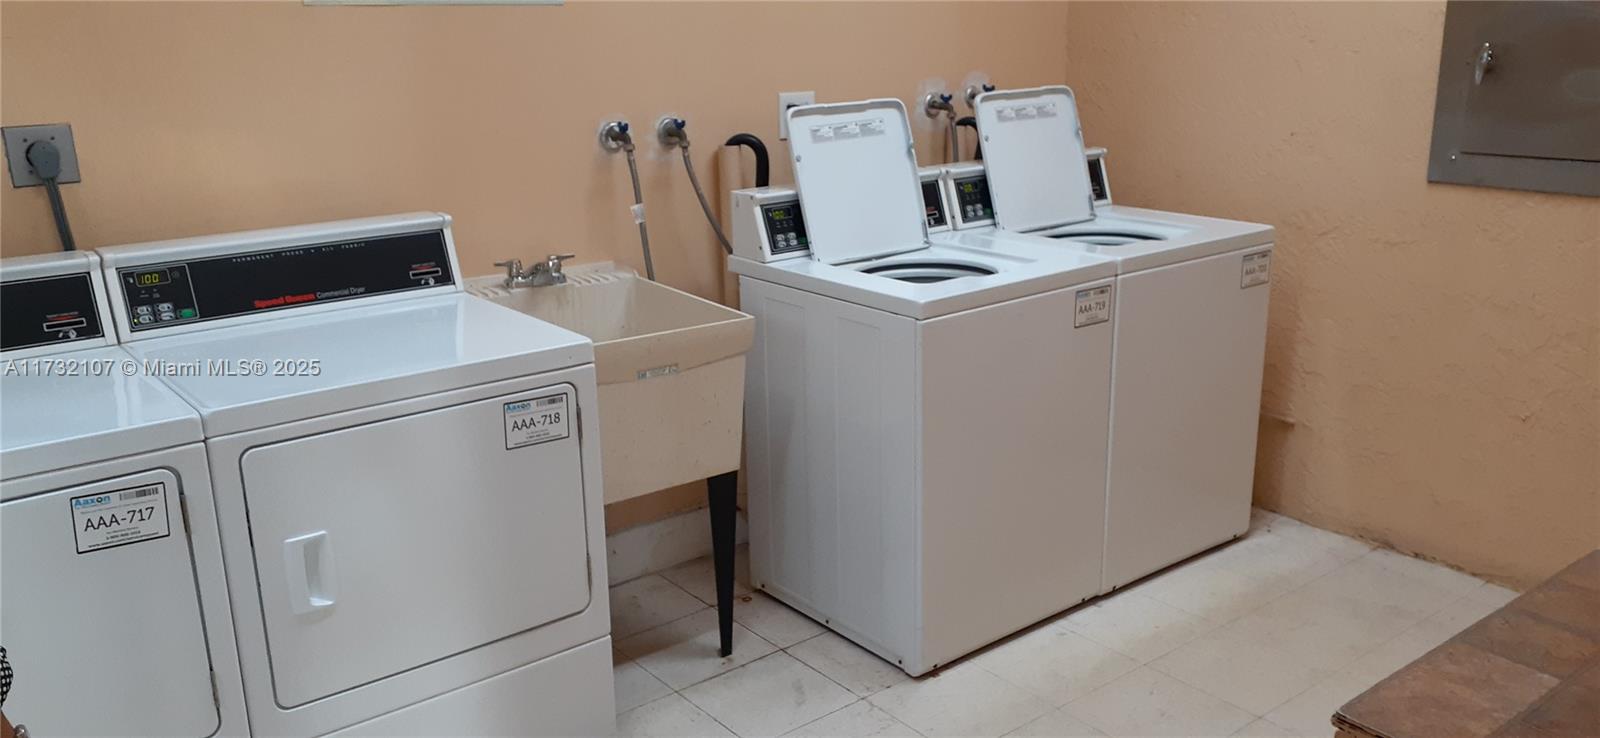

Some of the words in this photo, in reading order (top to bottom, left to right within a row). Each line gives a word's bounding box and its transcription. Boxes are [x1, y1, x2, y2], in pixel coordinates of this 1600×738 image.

[141, 273, 159, 284] 100
[317, 288, 350, 299] Commercial
[350, 286, 366, 295] Dryer
[1078, 300, 1106, 315] AAA-719
[511, 412, 561, 432] AAA-718
[74, 495, 111, 506] Aaxon
[84, 506, 155, 532] AAA-717
